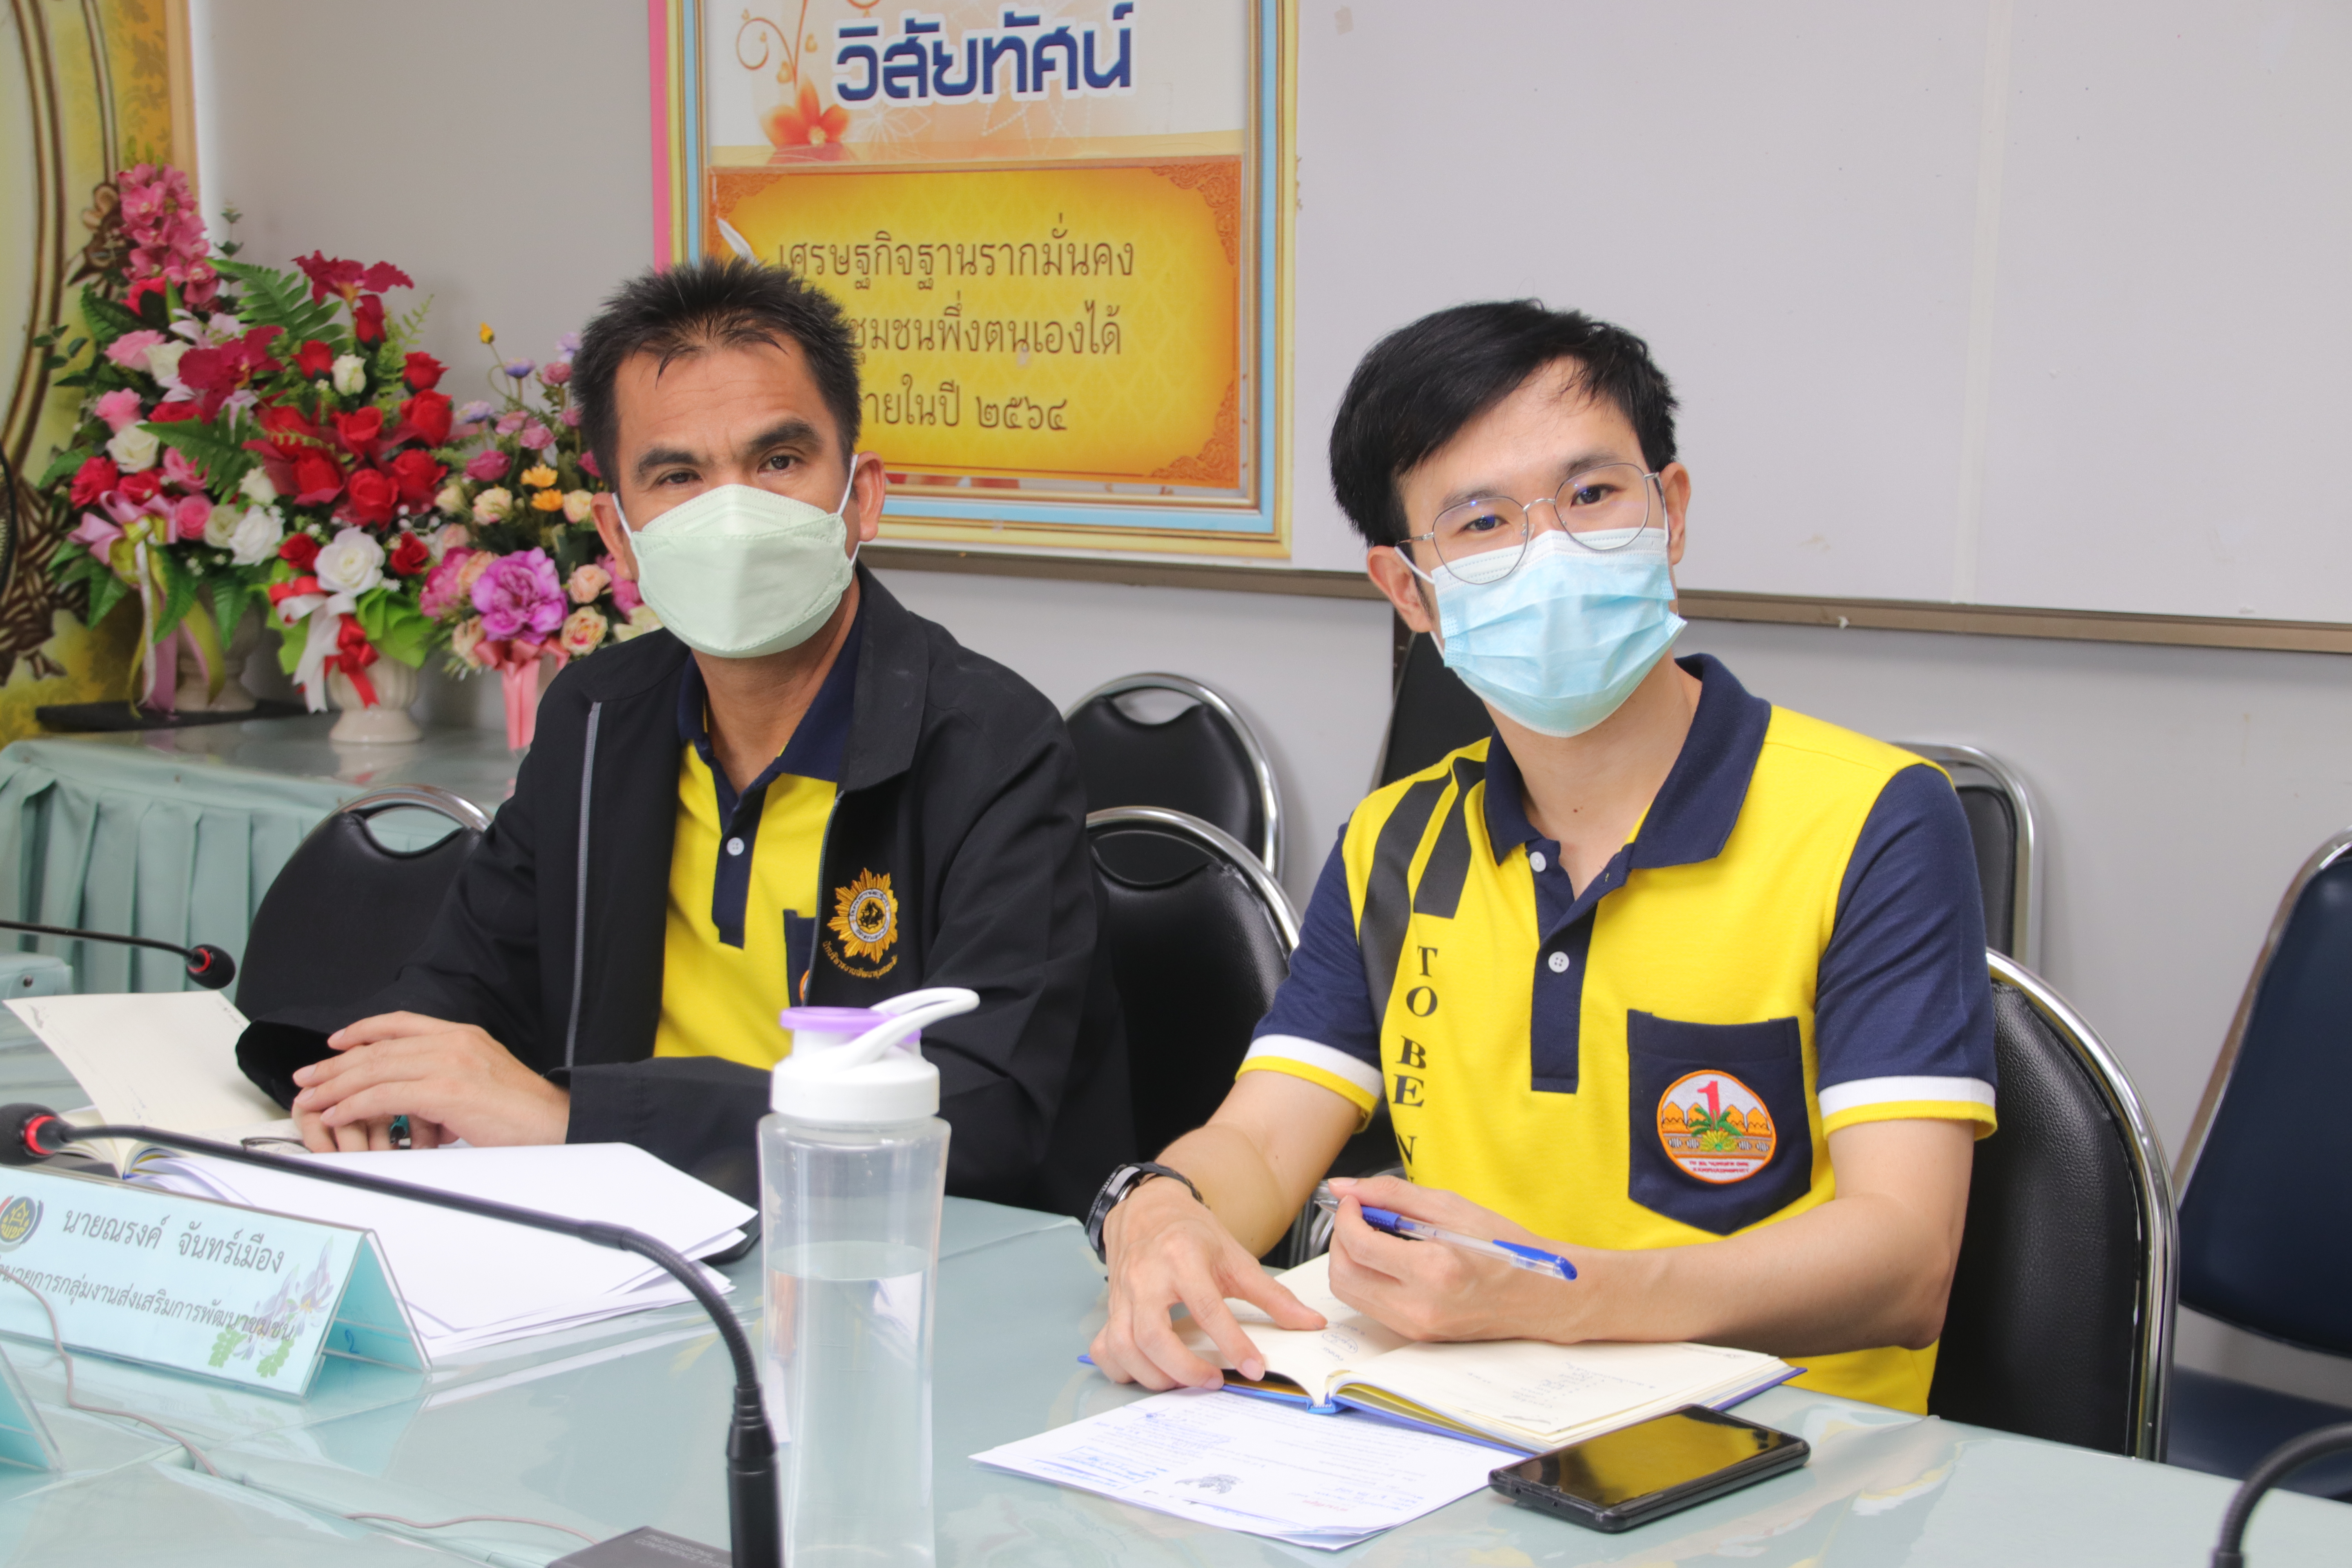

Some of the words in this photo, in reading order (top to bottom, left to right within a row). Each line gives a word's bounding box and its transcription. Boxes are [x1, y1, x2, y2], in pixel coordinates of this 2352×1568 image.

[837, 2, 1134, 101] วิสัยทัศน์
[780, 212, 1134, 290] เศรษฐกิจฐานรากมั่นคง
[864, 374, 960, 426] ายในปี
[976, 396, 1068, 430] ๒๕๖๔
[1406, 945, 1438, 1017] TO
[1392, 1035, 1427, 1107] BE
[63, 1209, 171, 1249] นายณรงค์
[179, 1221, 285, 1274] จันทร์เมือง
[634, 1539, 702, 1561] CONFERENCE
[644, 1534, 716, 1559] PROFESSIONAL
